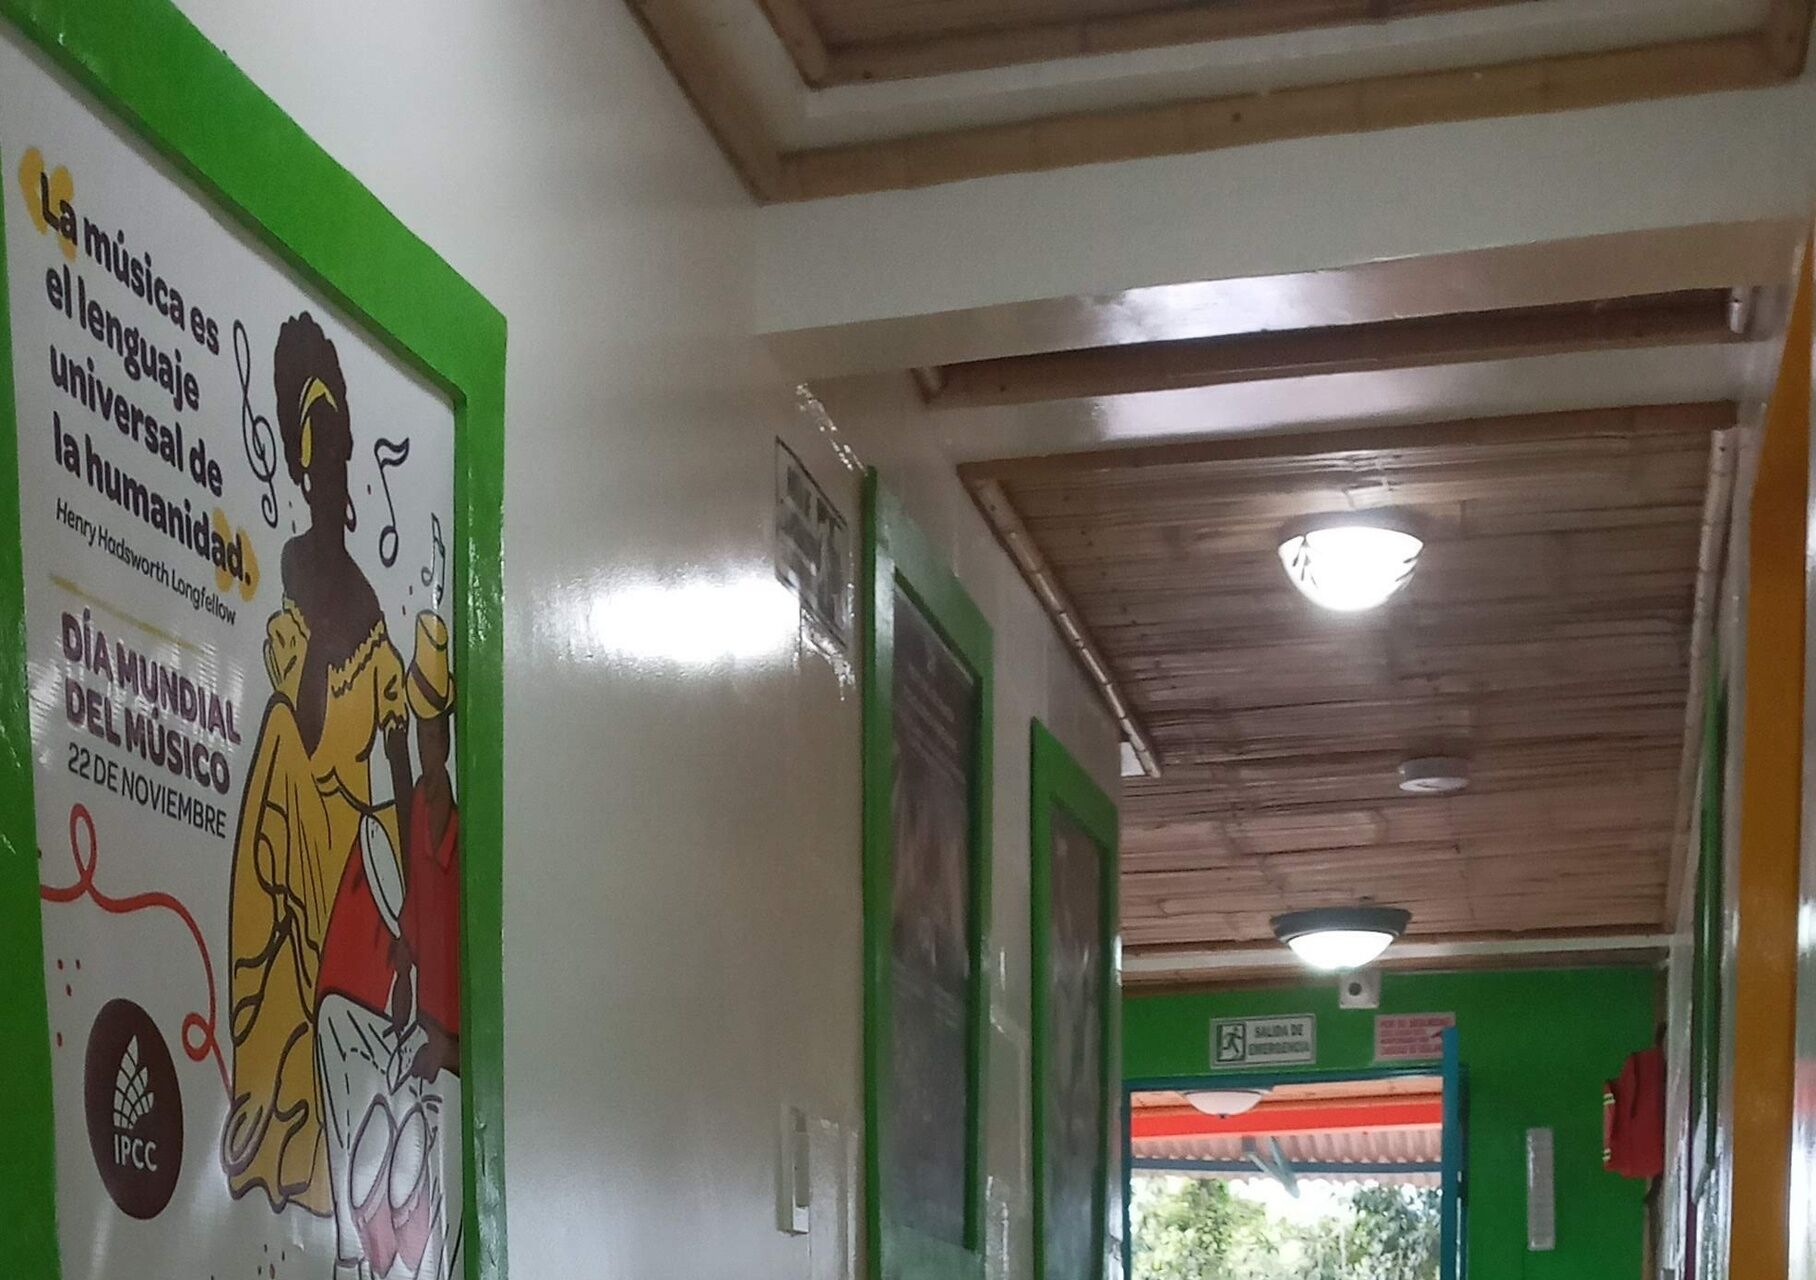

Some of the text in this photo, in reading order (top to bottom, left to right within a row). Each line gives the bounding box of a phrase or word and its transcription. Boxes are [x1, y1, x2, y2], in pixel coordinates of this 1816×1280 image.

[40, 171, 220, 357] La música es
[46, 263, 200, 412] el lenguaje
[50, 344, 223, 498] universal de
[53, 410, 252, 586] la humanidad.
[56, 498, 236, 626] Henry Hadsworth Longfellow
[61, 607, 242, 746] DÍA MUNDIAL
[65, 677, 230, 796] DEL MÚSICO
[67, 742, 227, 839] 22 DE NOVIEMBRE
[1255, 1023, 1304, 1038] SALIDA DE
[114, 1133, 158, 1172] IPCC
